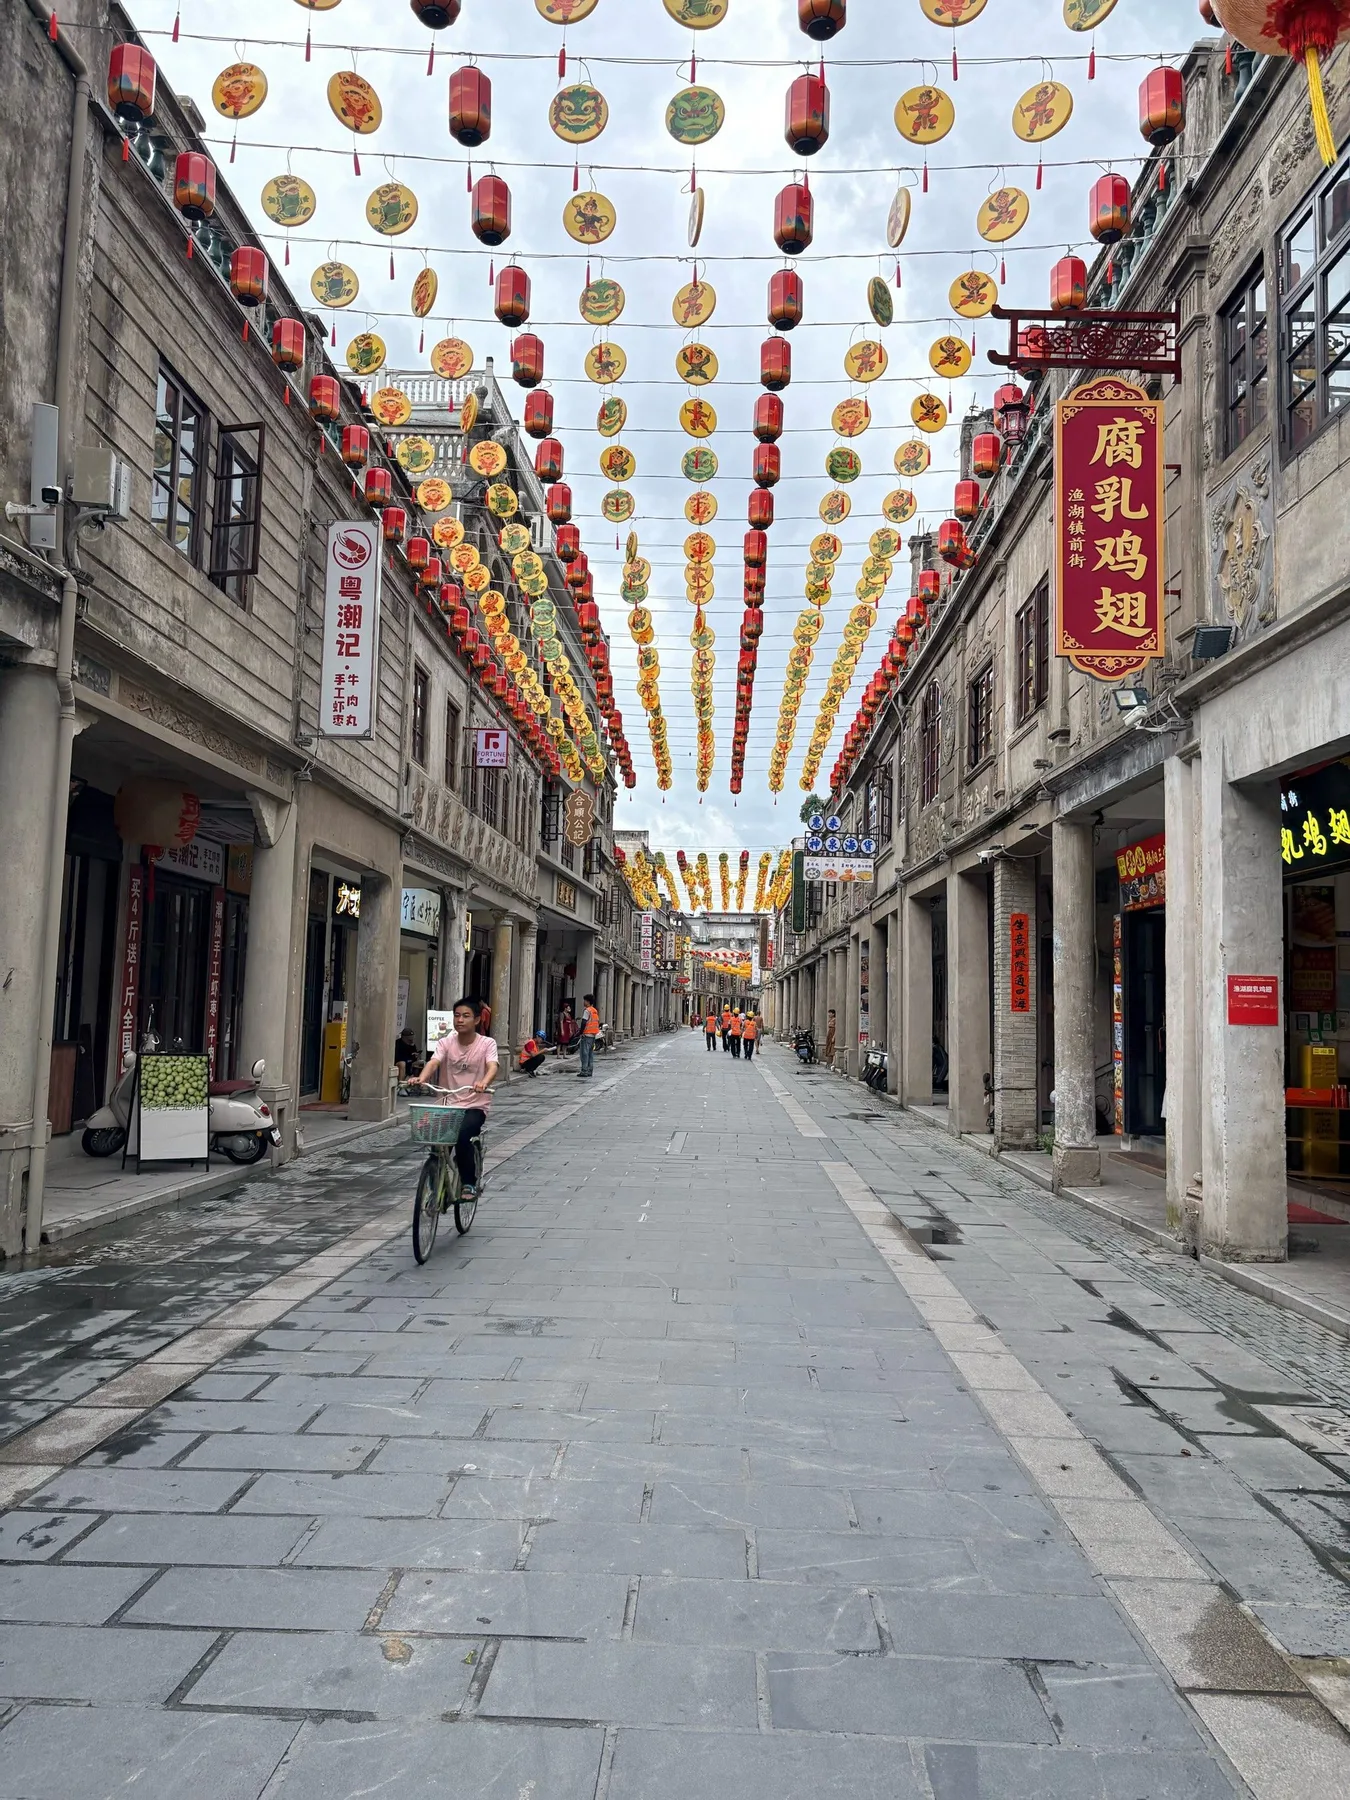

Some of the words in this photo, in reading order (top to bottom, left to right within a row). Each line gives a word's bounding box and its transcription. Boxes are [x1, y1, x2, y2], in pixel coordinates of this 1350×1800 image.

[1067, 489, 1086, 569] 渔湖镇前街
[1089, 417, 1153, 638] 腐乳鸡翅
[333, 674, 346, 726] 手工虾枣
[346, 674, 359, 726] 牛肉丸
